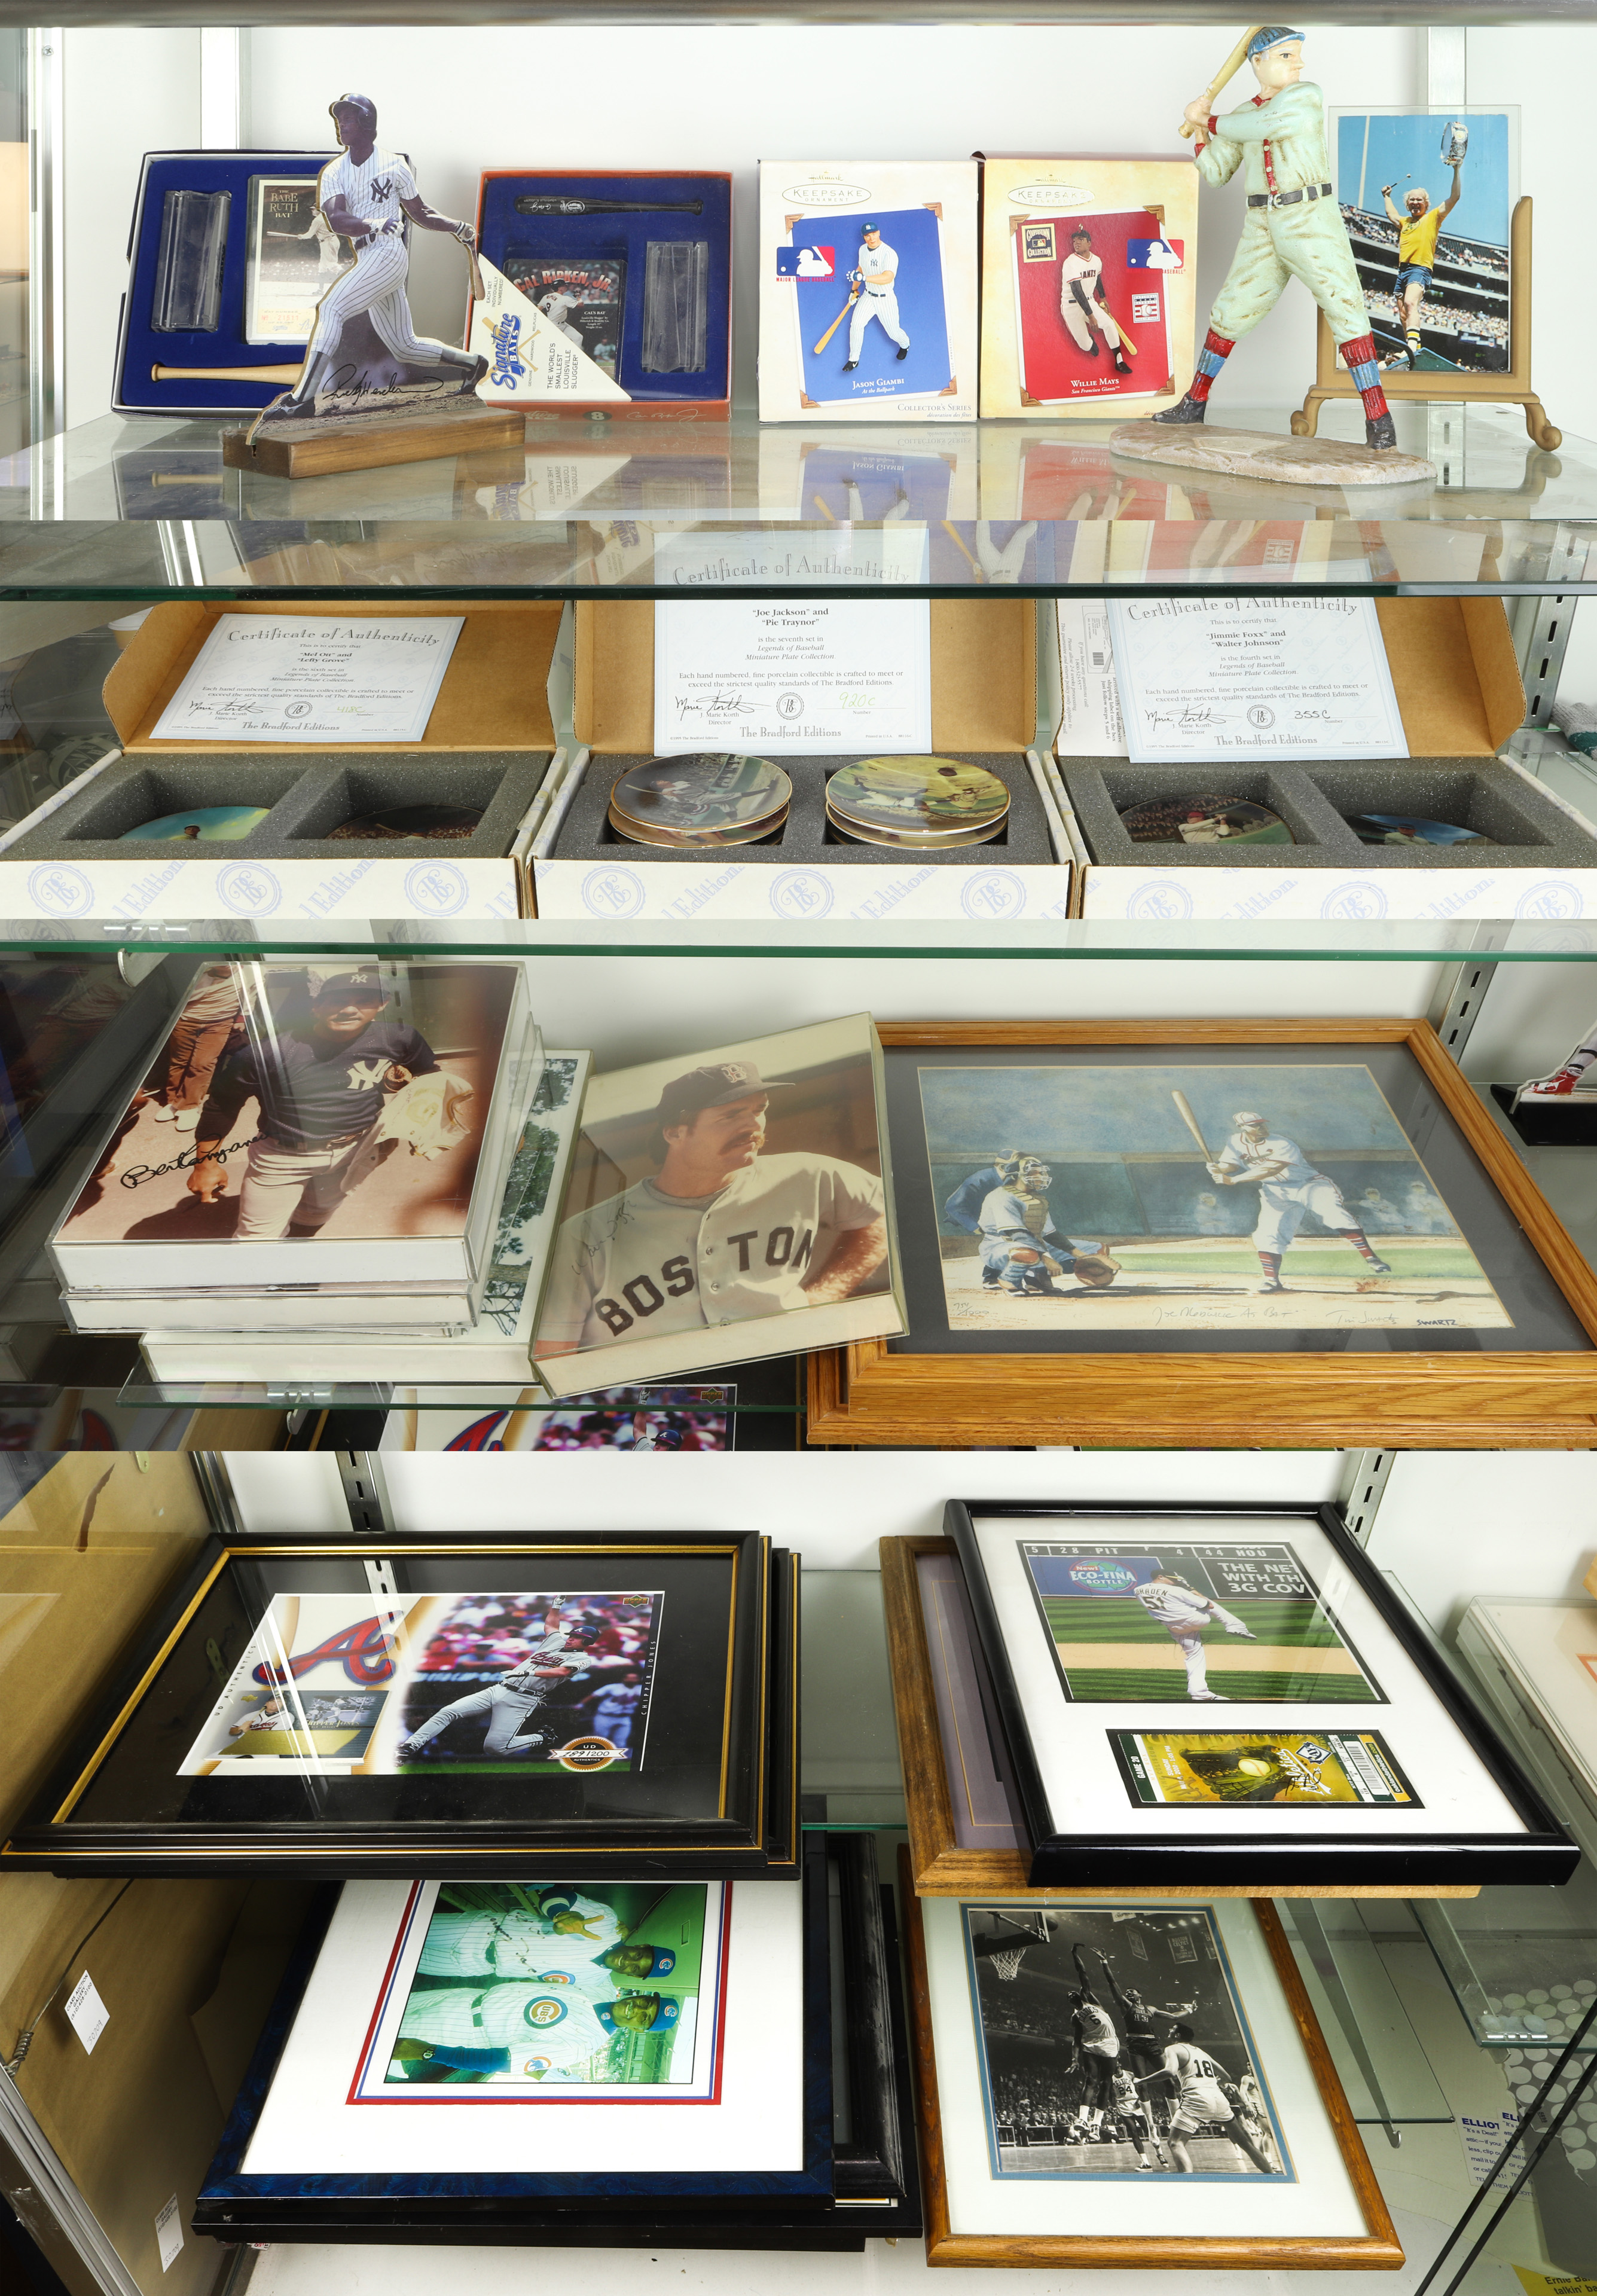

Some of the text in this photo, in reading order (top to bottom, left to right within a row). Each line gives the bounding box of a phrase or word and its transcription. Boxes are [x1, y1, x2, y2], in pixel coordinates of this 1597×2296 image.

[271, 193, 298, 202] BABE
[793, 189, 863, 198] KEEPSAKE
[269, 203, 298, 213] RUTH
[1027, 247, 1051, 257] COLLECTION
[513, 270, 612, 292] CAL RIPKEN, JR.
[490, 313, 517, 390] Signature
[509, 329, 518, 364] BATS
[853, 378, 905, 390] JASON GIAMBI
[591, 411, 604, 420] 8
[673, 554, 909, 585] Certificate of Authenticity
[1128, 598, 1357, 620] Certificate of Authenticity
[228, 628, 440, 646] Certificate of Authenticity
[740, 725, 841, 738] The Bradford Editions
[346, 1059, 393, 1091] NY
[721, 1064, 746, 1083] B
[1217, 1562, 1257, 1573] THE
[1222, 1573, 1270, 1582] WITH
[1228, 1583, 1257, 1593] 3G
[1142, 1596, 1167, 1610] 51
[224, 1645, 257, 1699] AUTHENTICS
[642, 1675, 652, 1715] CHIPPER
[1135, 1764, 1146, 1779] GAME
[1162, 1758, 1174, 1776] SUNDAY
[1368, 1744, 1400, 1792] oaklandathletics.com
[67, 1974, 88, 2011] CLARS AUCTION
[74, 1987, 85, 2007] GALLERY
[1134, 2014, 1148, 2022] 13
[1194, 2059, 1214, 2078] 18
[1117, 2086, 1132, 2095] 24
